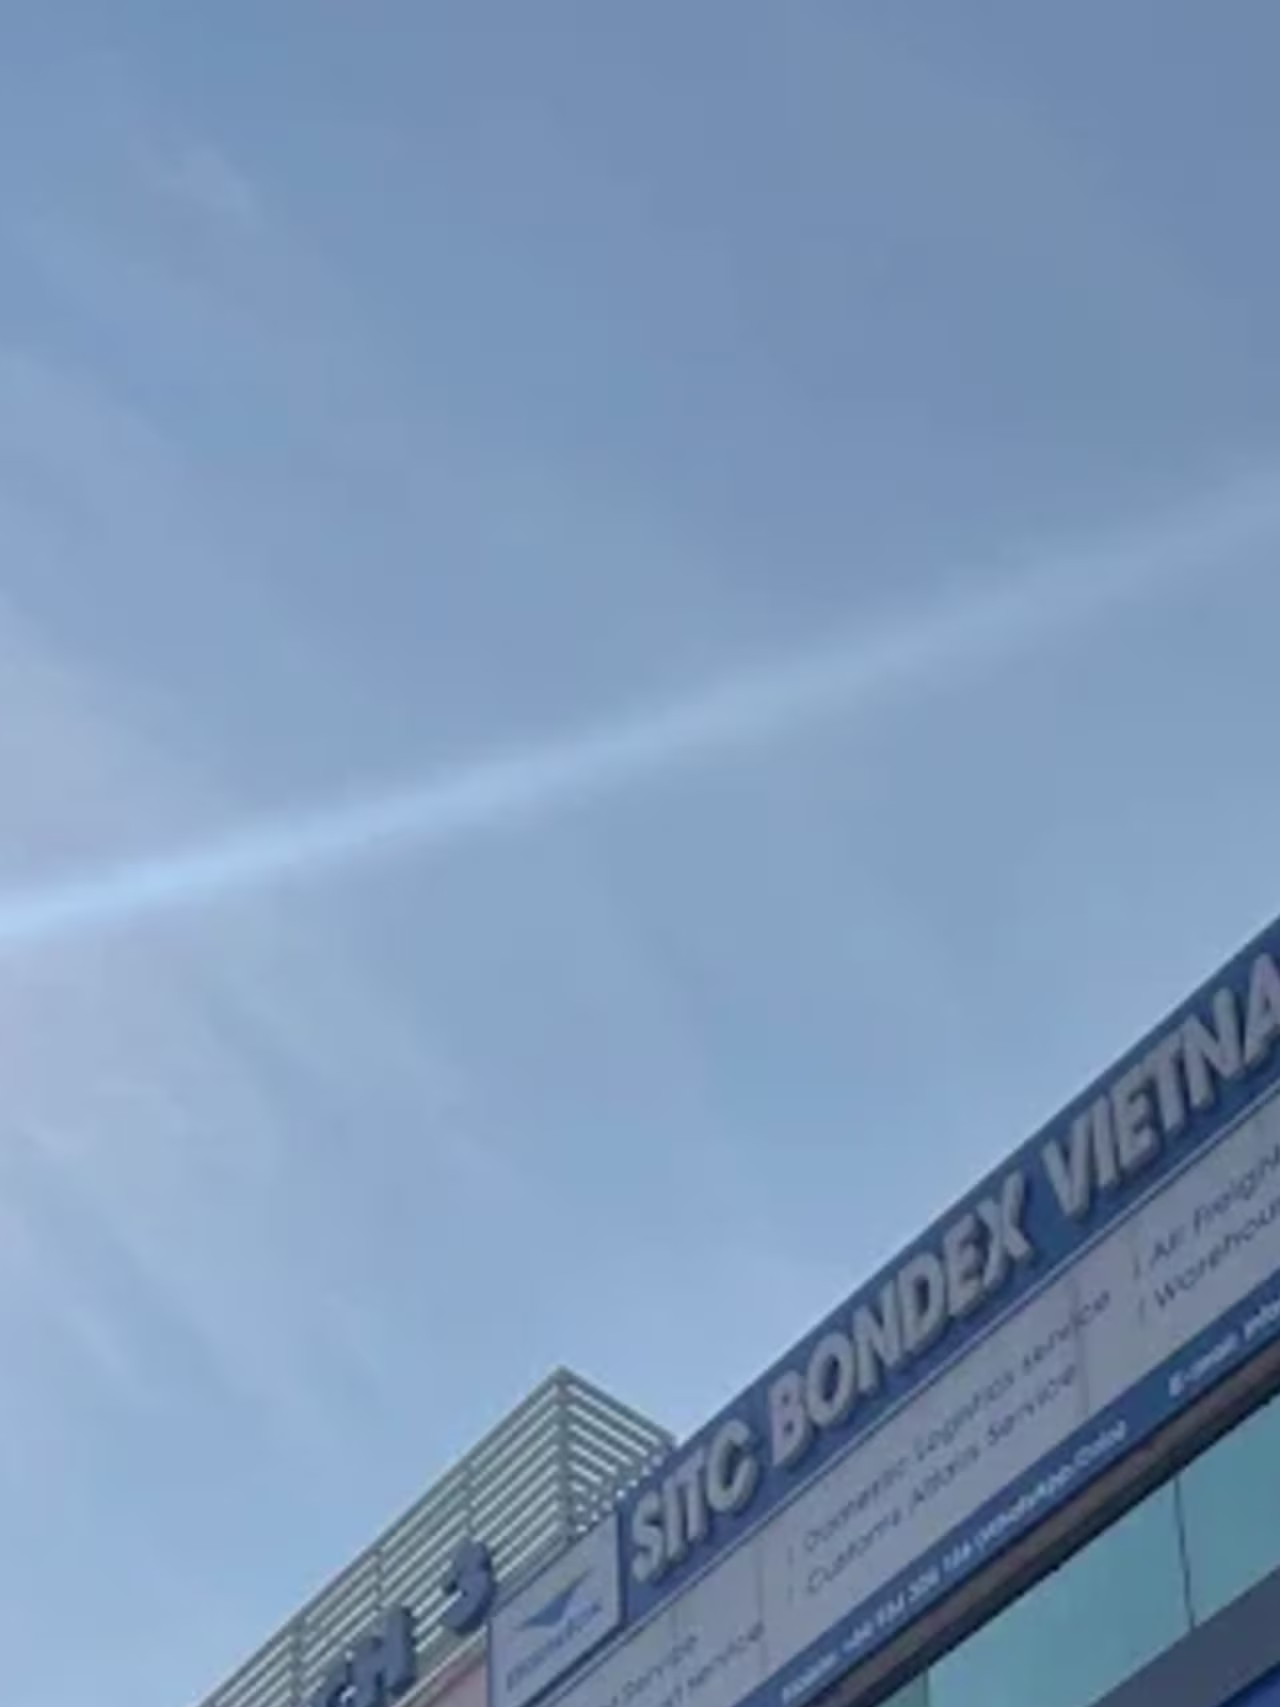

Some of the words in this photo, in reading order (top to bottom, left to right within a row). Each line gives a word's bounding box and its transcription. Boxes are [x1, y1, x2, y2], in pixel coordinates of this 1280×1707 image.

[630, 1420, 758, 1583] SITC
[766, 1170, 1036, 1470] BONDEX
[441, 1540, 498, 1634] 3
